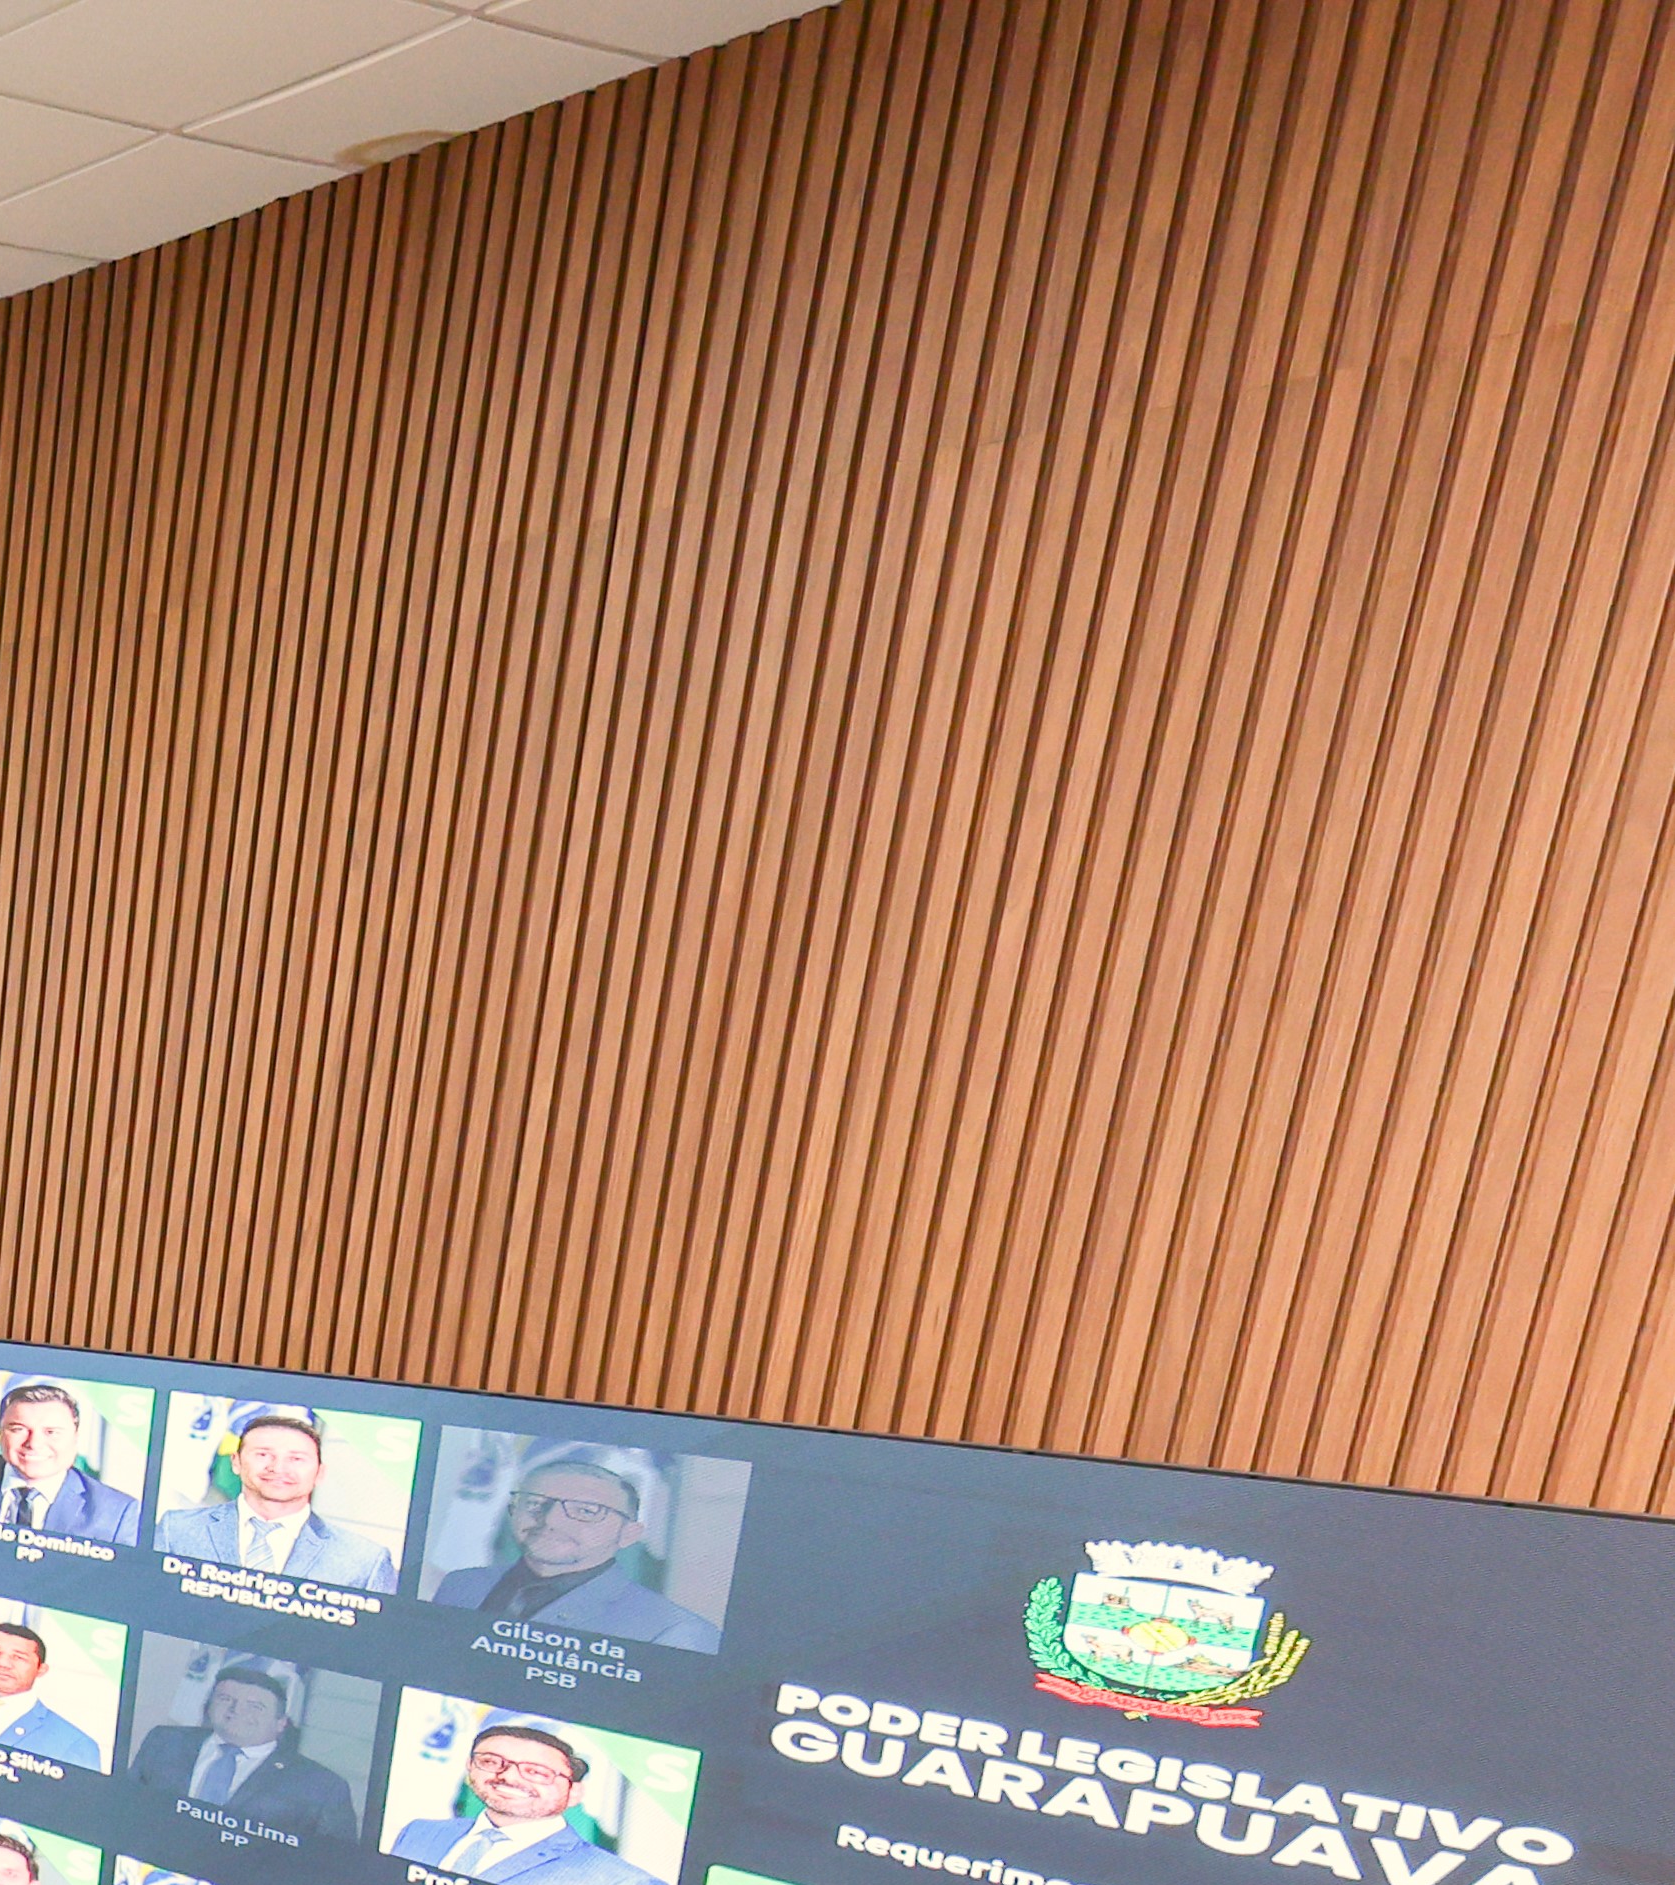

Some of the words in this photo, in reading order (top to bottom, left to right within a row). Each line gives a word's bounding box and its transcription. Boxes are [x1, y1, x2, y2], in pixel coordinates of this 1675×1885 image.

[15, 1544, 45, 1563] PP
[16, 1526, 116, 1562] Dominico
[161, 1554, 197, 1578] Dr.
[199, 1562, 296, 1598] Rodrigo
[298, 1581, 383, 1614] Crema
[179, 1577, 357, 1627] REPUBLICANOS
[469, 1634, 643, 1684] Ambulância
[491, 1618, 583, 1652] Gilson
[589, 1638, 627, 1660] da
[525, 1666, 578, 1691] PSB
[9, 1750, 65, 1780] Silvio
[774, 1682, 1008, 1759] PODER
[1028, 1729, 1576, 1867] LEGISLATIVO
[174, 1798, 242, 1830] Paulo
[242, 1818, 301, 1849] Lima
[219, 1830, 250, 1849] PP
